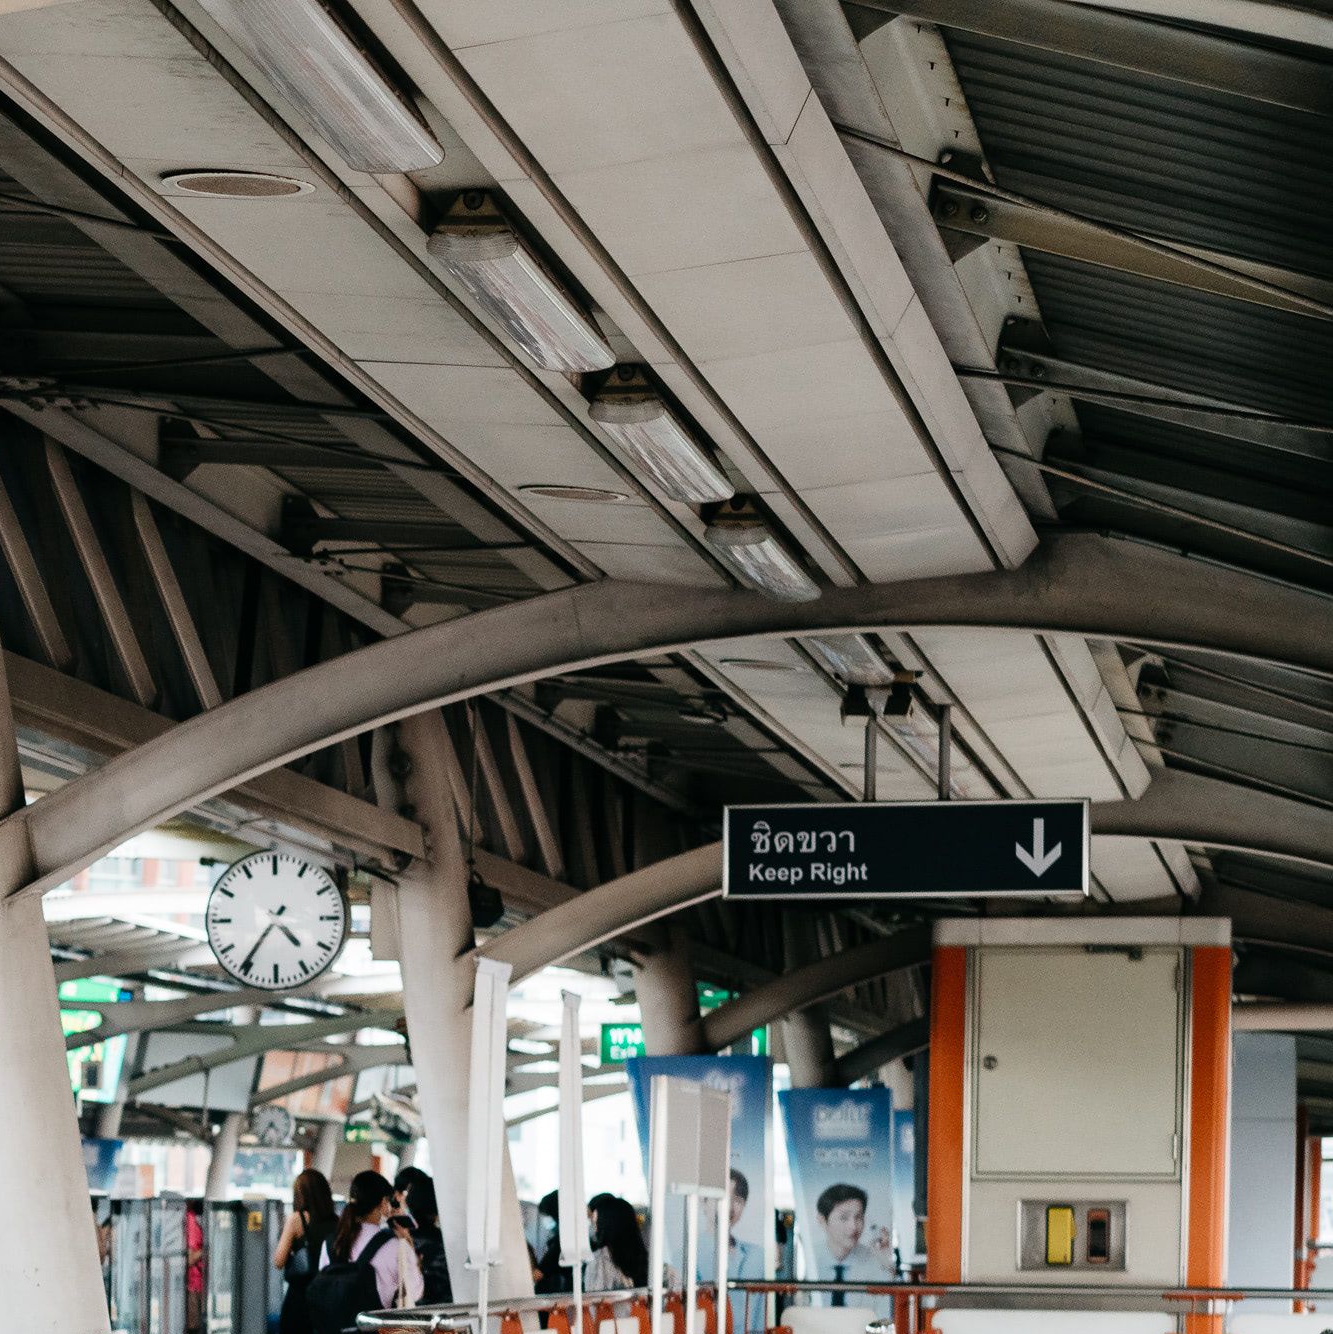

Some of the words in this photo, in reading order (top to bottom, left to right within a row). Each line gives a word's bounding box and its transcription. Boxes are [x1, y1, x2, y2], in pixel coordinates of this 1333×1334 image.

[750, 820, 856, 854] ชิดขวา
[749, 863, 804, 885] Keep
[810, 862, 868, 885] Right
